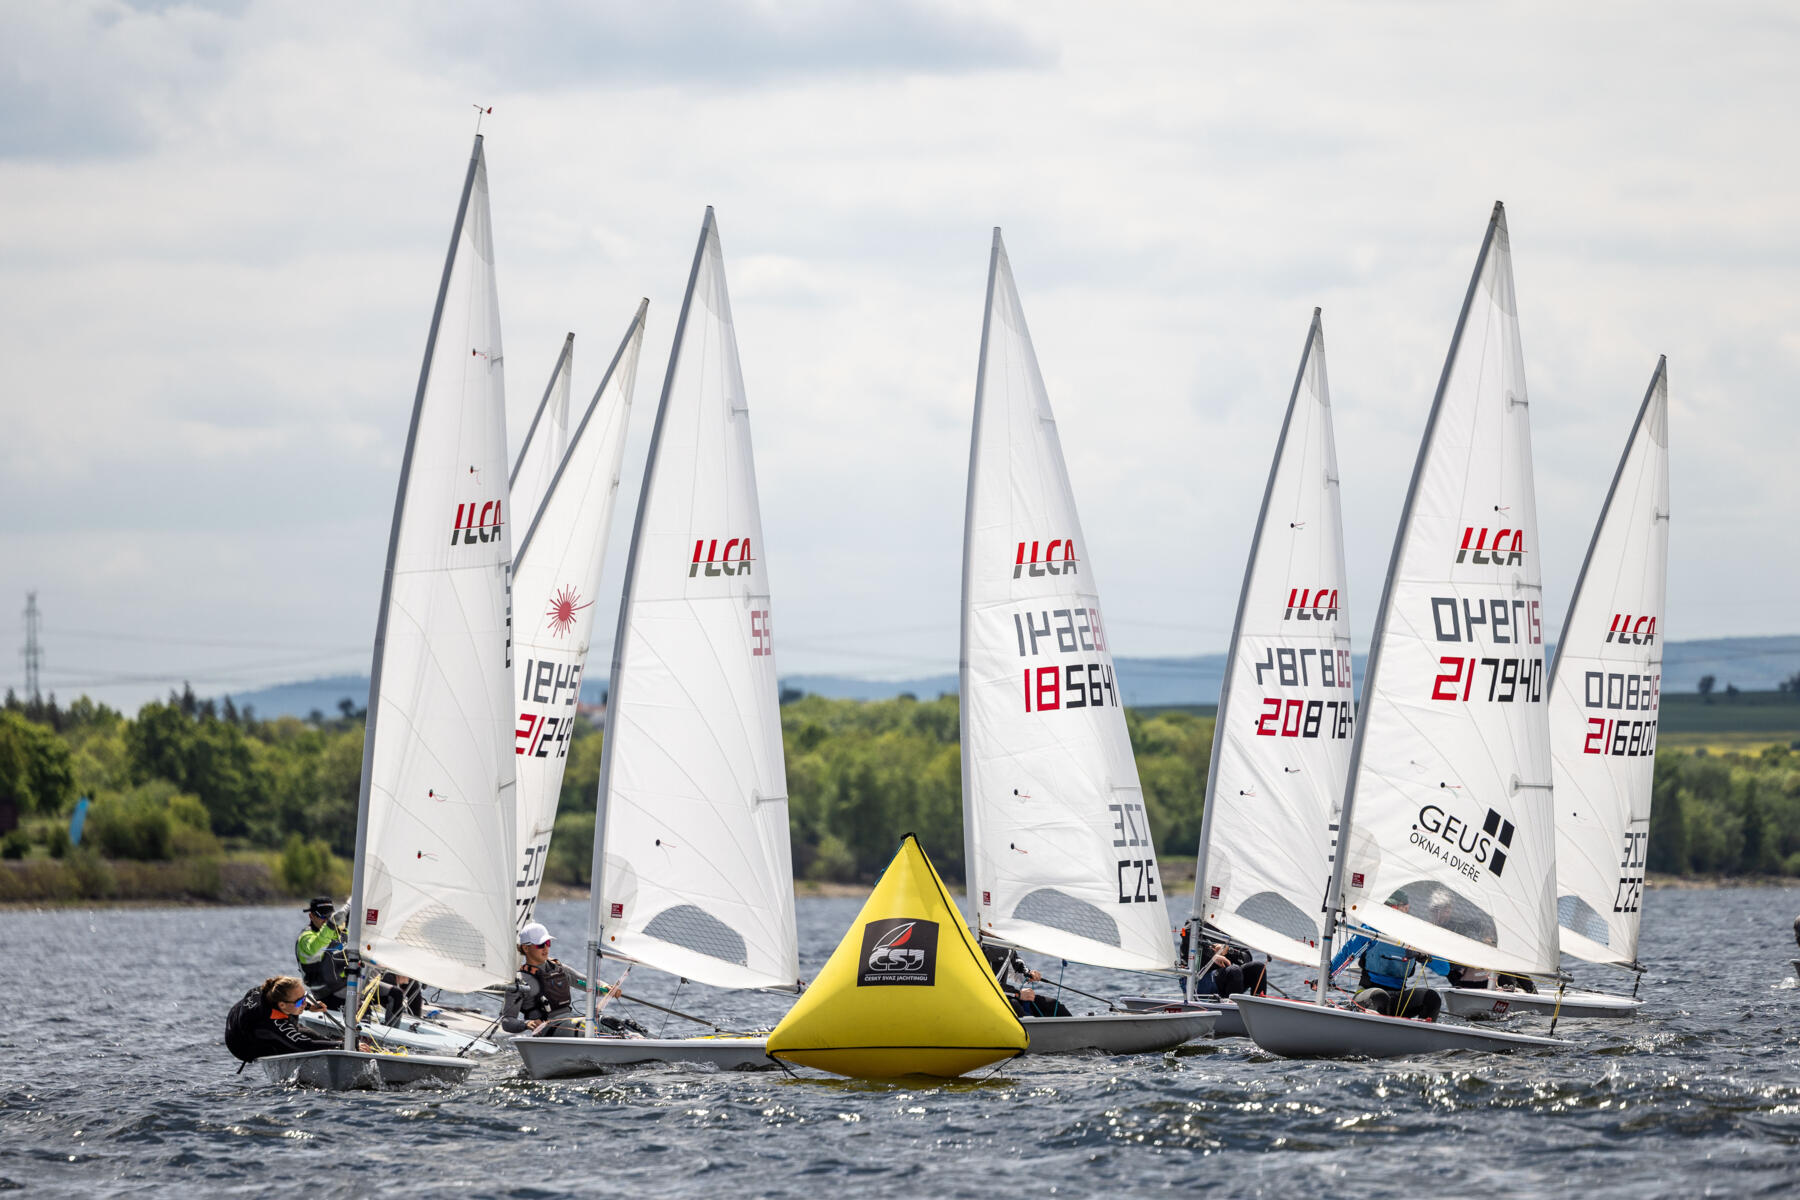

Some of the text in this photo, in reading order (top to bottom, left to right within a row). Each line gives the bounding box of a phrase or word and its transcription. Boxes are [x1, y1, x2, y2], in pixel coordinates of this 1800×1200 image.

[451, 500, 502, 546] ILCA
[689, 538, 752, 578] ILCA
[1013, 539, 1078, 579] ILCA
[1456, 527, 1524, 567] ILCA
[1284, 588, 1338, 621] ILCA
[1605, 614, 1657, 646] ILCA
[1024, 664, 1118, 712] 185641
[1432, 656, 1542, 702] 217940
[1410, 832, 1440, 858] OKNA
[1441, 851, 1449, 863] A
[1419, 805, 1491, 863] GEUS
[1118, 859, 1158, 903] CZE
[1613, 878, 1643, 912] CZE
